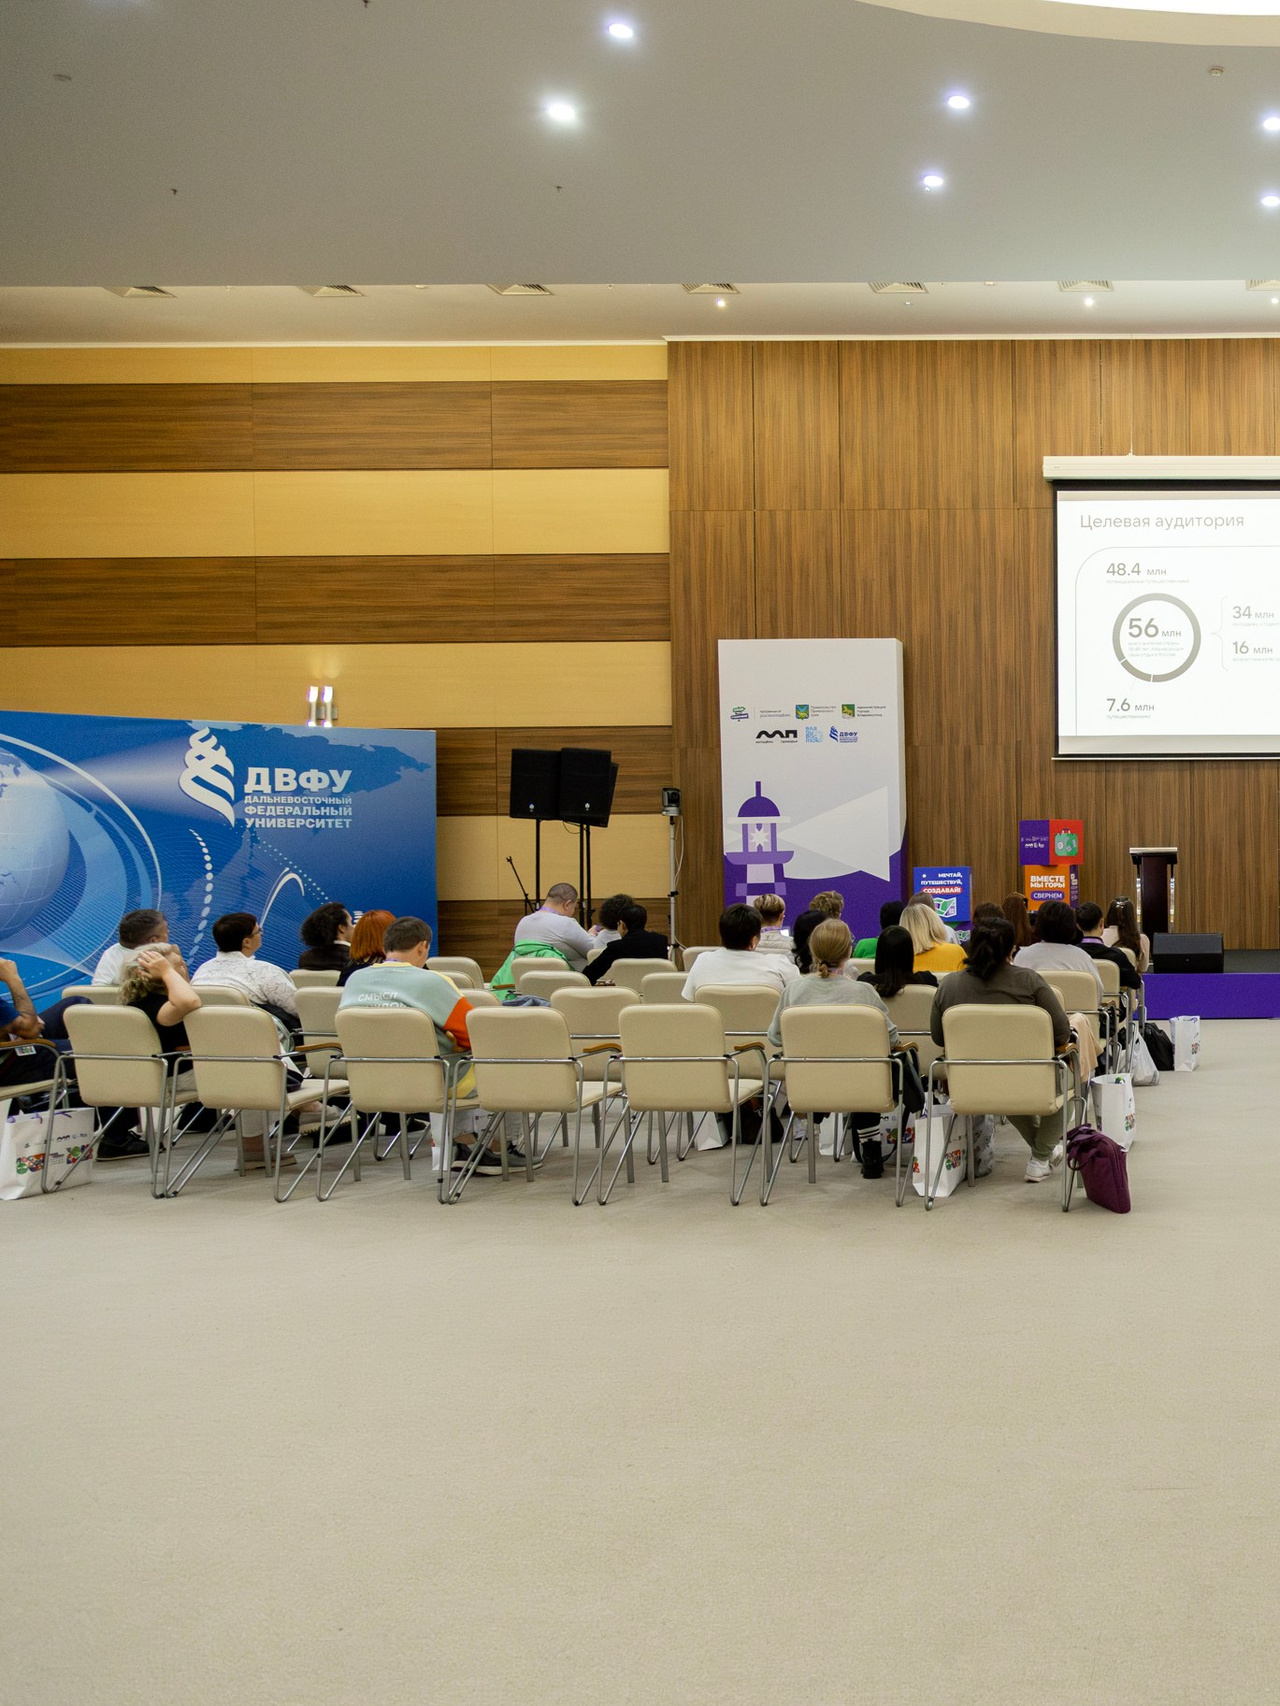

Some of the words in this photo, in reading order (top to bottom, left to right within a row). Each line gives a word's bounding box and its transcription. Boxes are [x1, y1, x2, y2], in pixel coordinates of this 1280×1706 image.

[1080, 514, 1150, 530] Целевая
[1155, 514, 1245, 530] аудитория
[1106, 562, 1141, 576] 48.4
[1232, 605, 1252, 619] 34
[1128, 618, 1160, 638] 56
[1232, 641, 1249, 655] 16
[1106, 698, 1131, 712] 7.6
[244, 767, 352, 794] ДВФУ
[244, 795, 352, 805] ДАЛЬНЕВОСТОЧНЫЙ
[244, 805, 352, 816] ФЕДЕРАЛЬНЫЙ
[244, 818, 352, 829] УНИВЕРСИТЕТ
[357, 992, 398, 1001] СМЫСЛ
